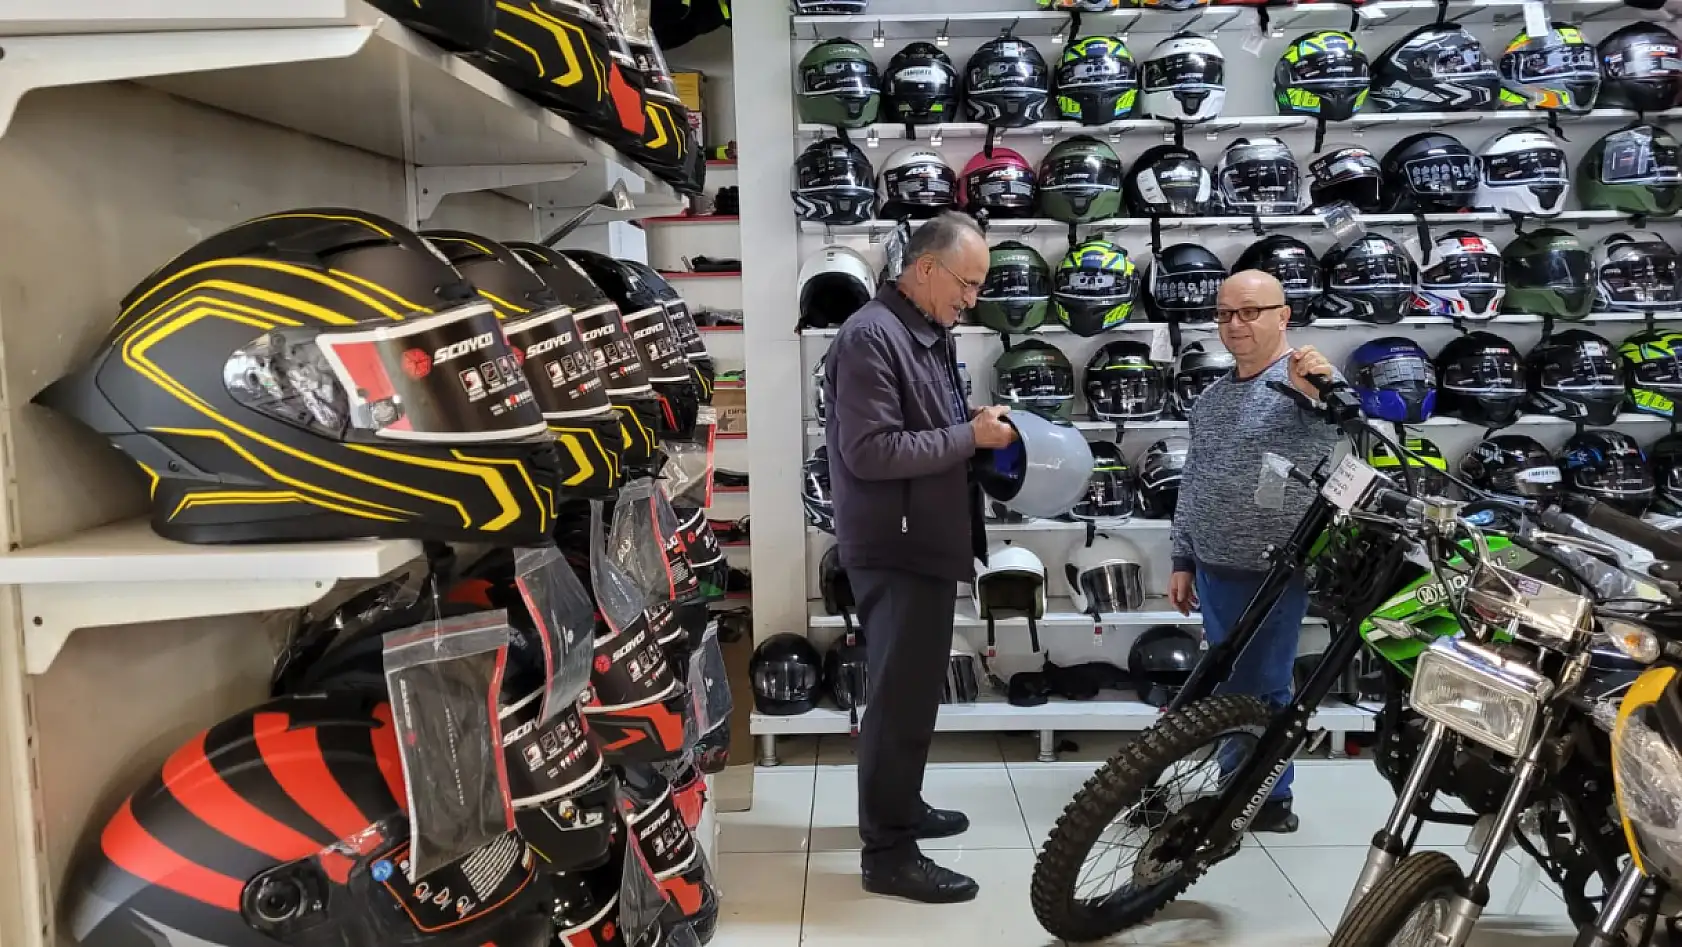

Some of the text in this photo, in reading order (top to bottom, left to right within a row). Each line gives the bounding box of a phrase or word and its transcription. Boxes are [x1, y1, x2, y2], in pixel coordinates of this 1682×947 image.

[525, 331, 572, 360] SCOYCO
[580, 322, 616, 342] COYCO
[433, 332, 494, 366] SCOYCO
[1242, 758, 1287, 818] MONDIAL
